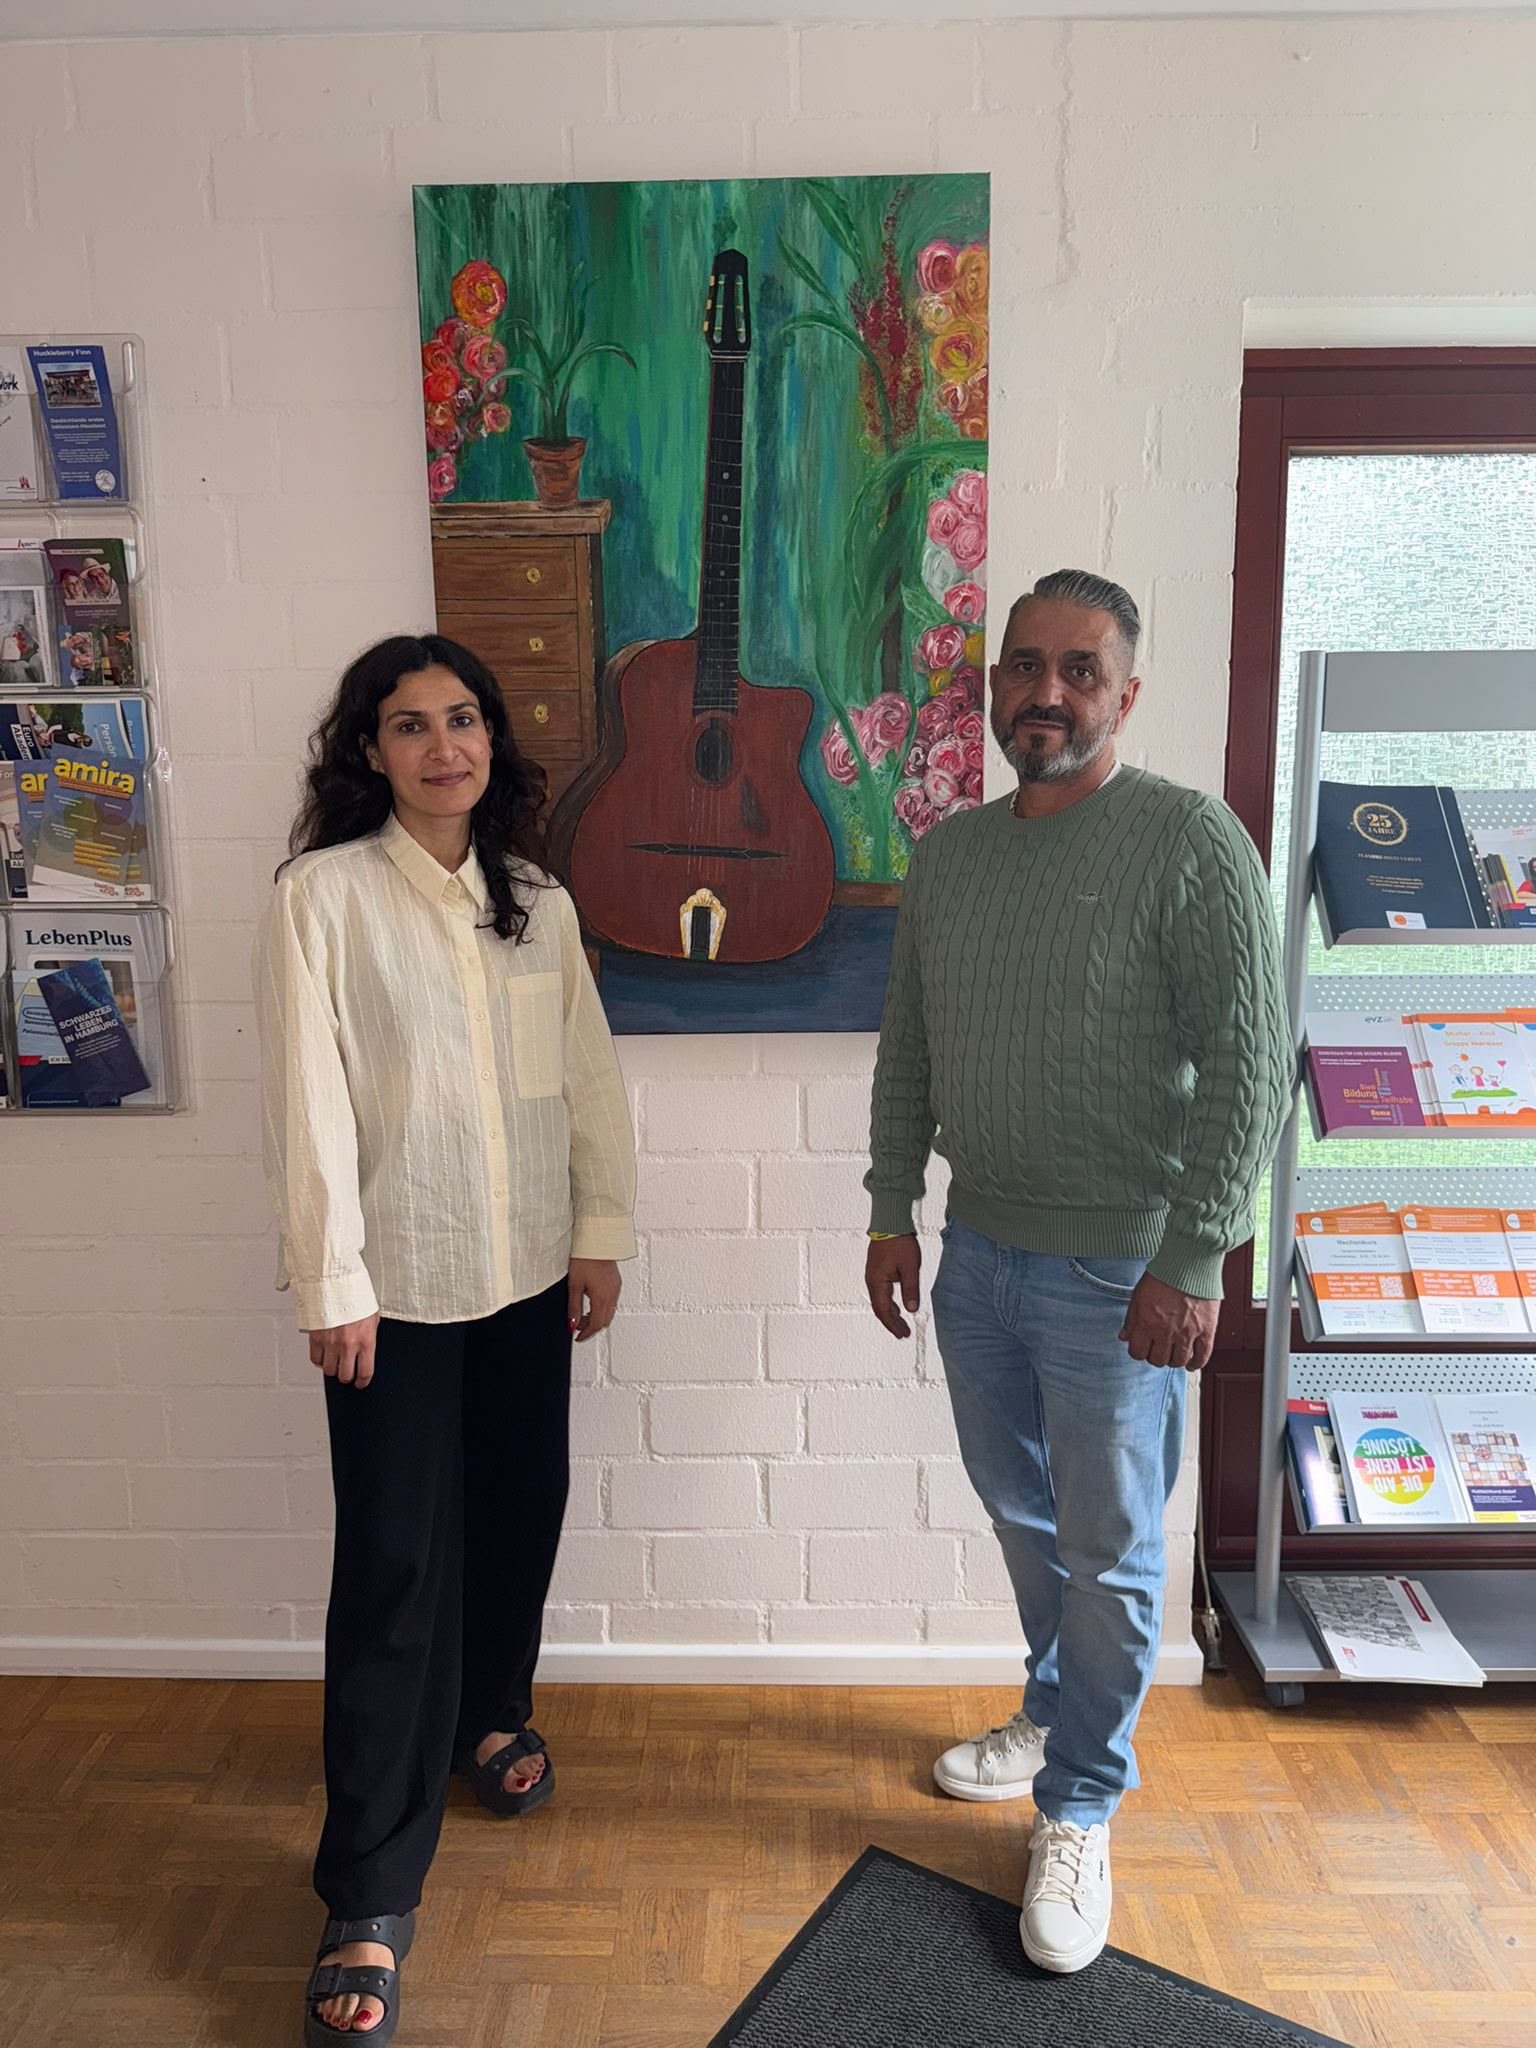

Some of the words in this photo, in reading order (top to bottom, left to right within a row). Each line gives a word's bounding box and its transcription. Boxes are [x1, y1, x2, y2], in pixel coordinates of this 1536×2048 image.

[22, 726, 35, 748] Euro
[54, 758, 135, 794] amira
[1366, 813, 1392, 828] 25
[1368, 827, 1397, 835] JAHRE
[25, 929, 132, 946] LebenPlus
[59, 1005, 112, 1029] SCHWARZES
[74, 1016, 103, 1032] LEBEN
[64, 1034, 75, 1044] IN
[75, 1019, 119, 1040] HAMBURG
[1343, 1088, 1378, 1099] Bildung
[1380, 1096, 1414, 1104] Teilhabe
[1361, 1437, 1417, 1457] LÖSUNG
[1364, 1457, 1401, 1475] KEINE
[1405, 1456, 1429, 1473] IST
[1400, 1475, 1424, 1493] DIE
